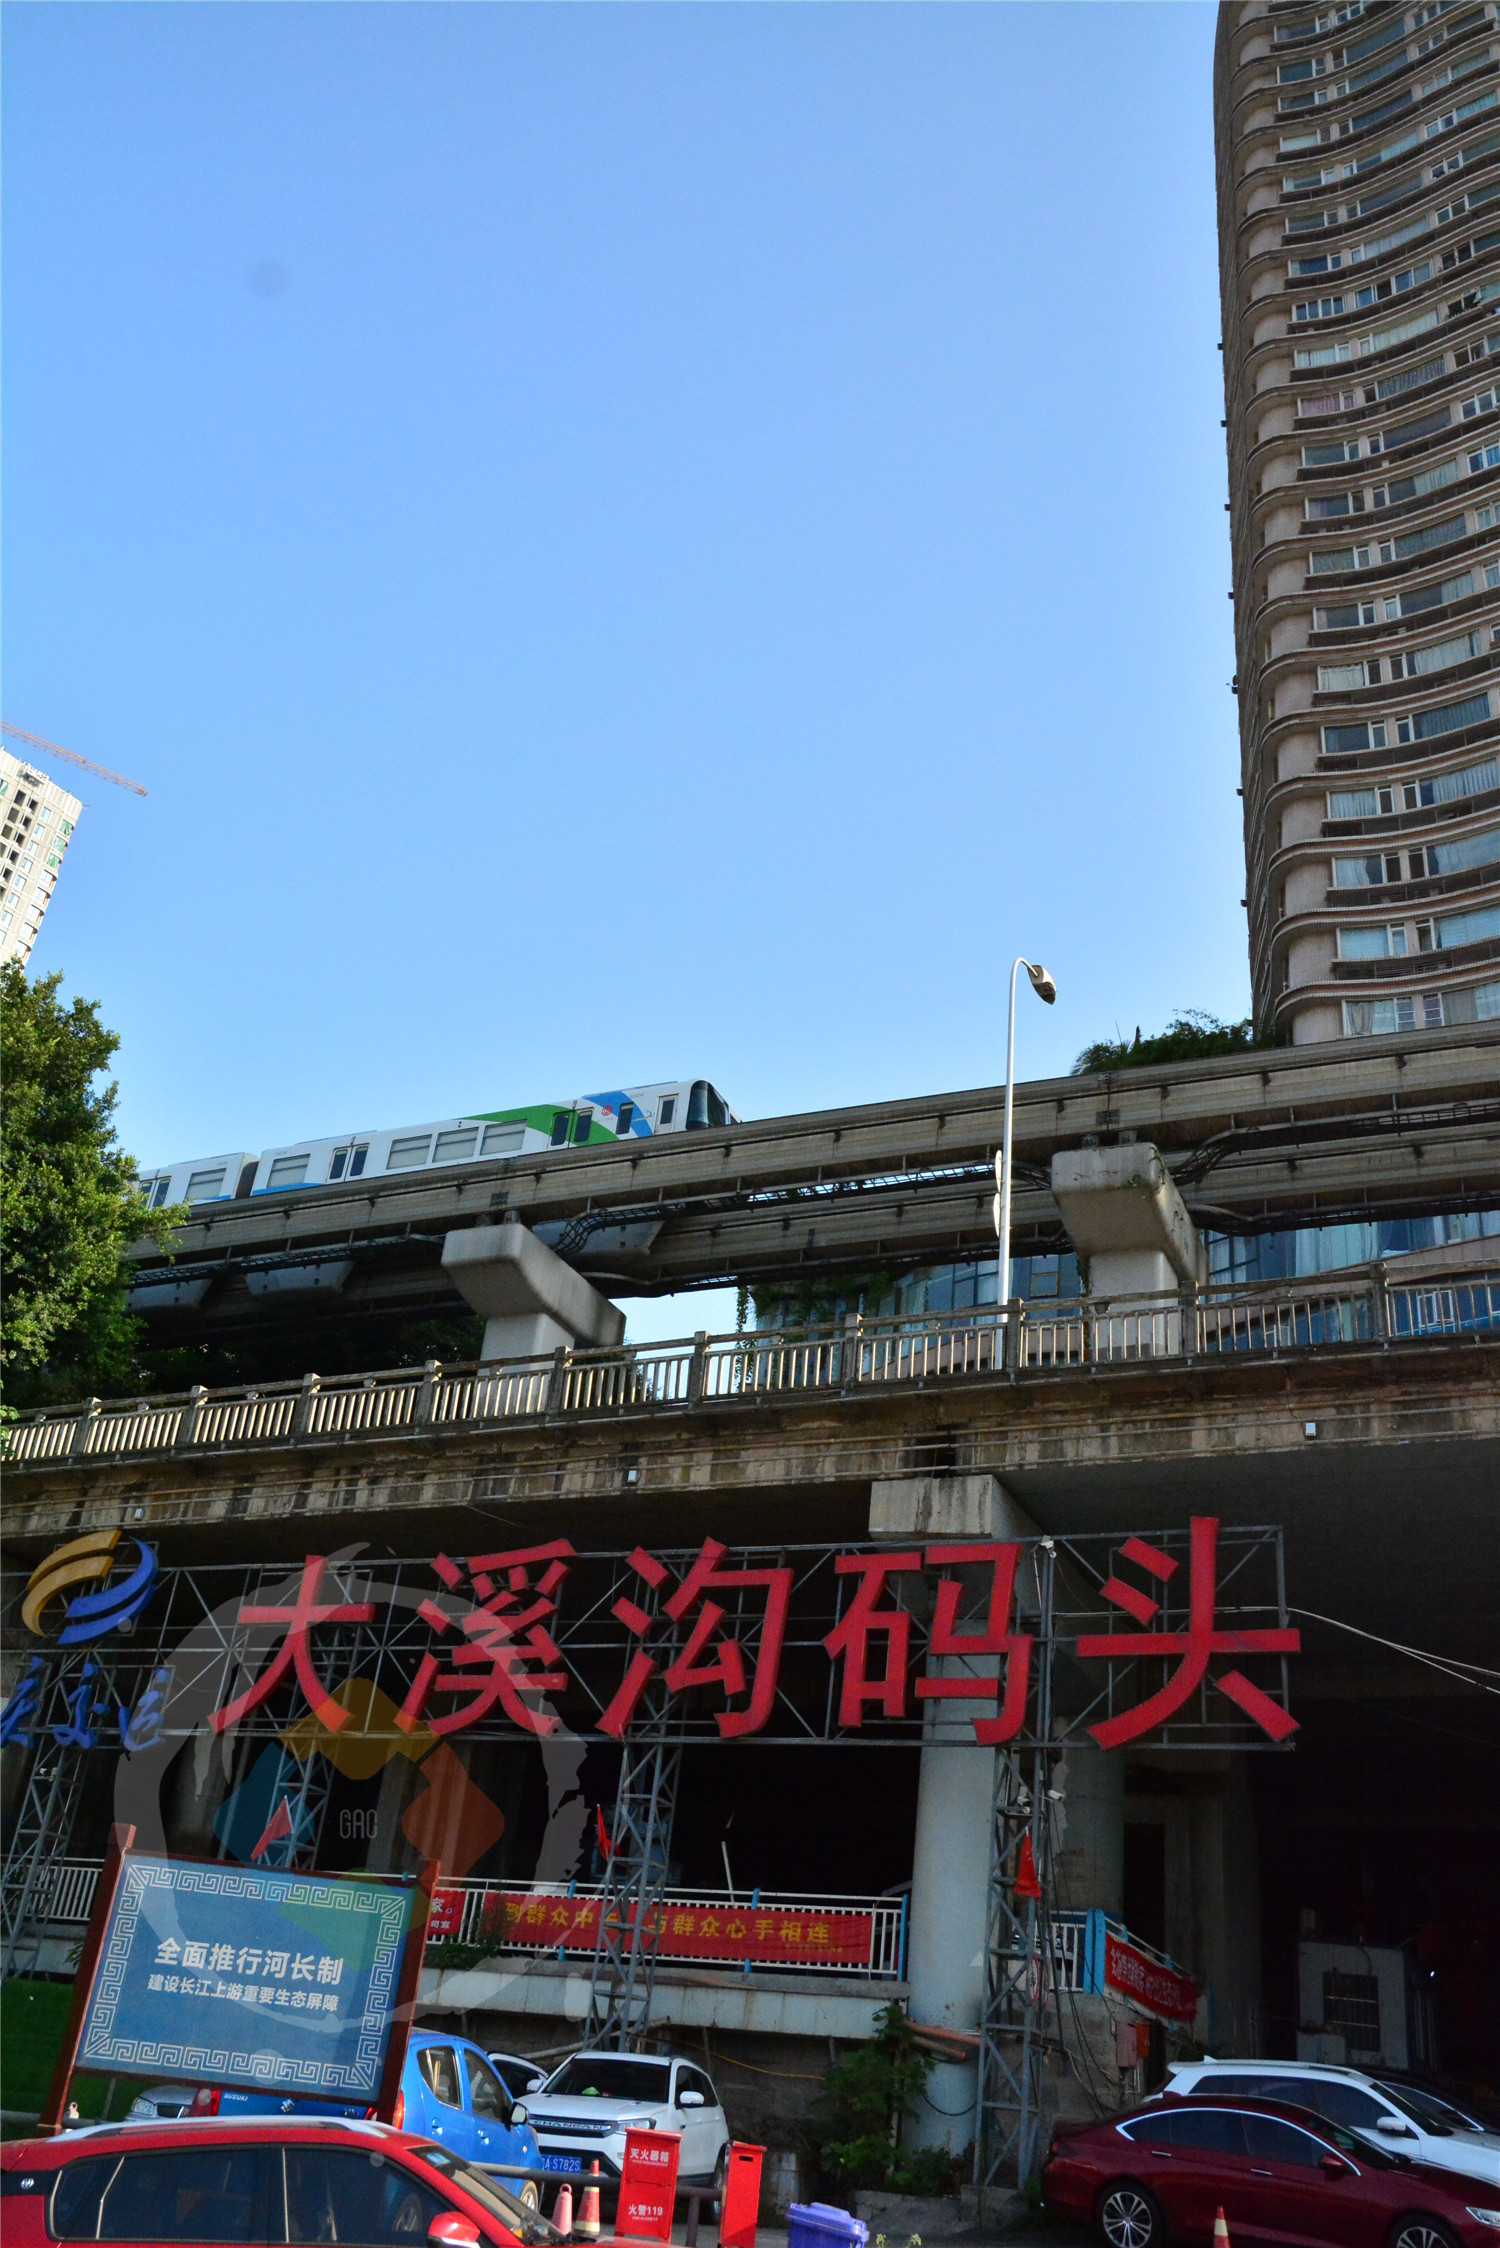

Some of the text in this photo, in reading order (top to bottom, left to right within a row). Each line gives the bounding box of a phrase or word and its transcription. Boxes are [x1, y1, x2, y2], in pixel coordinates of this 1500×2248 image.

[207, 1516, 1302, 1750] 大溪沟码头
[154, 1937, 344, 1985] 全面推行河长制
[147, 1974, 340, 2012] 建设长江上游重要生态屏障
[224, 2093, 249, 2102] SUZUKI
[533, 2119, 603, 2130] CHANGAN
[630, 2148, 670, 2162] 灭火器箱
[628, 2203, 663, 2217] 火警119
